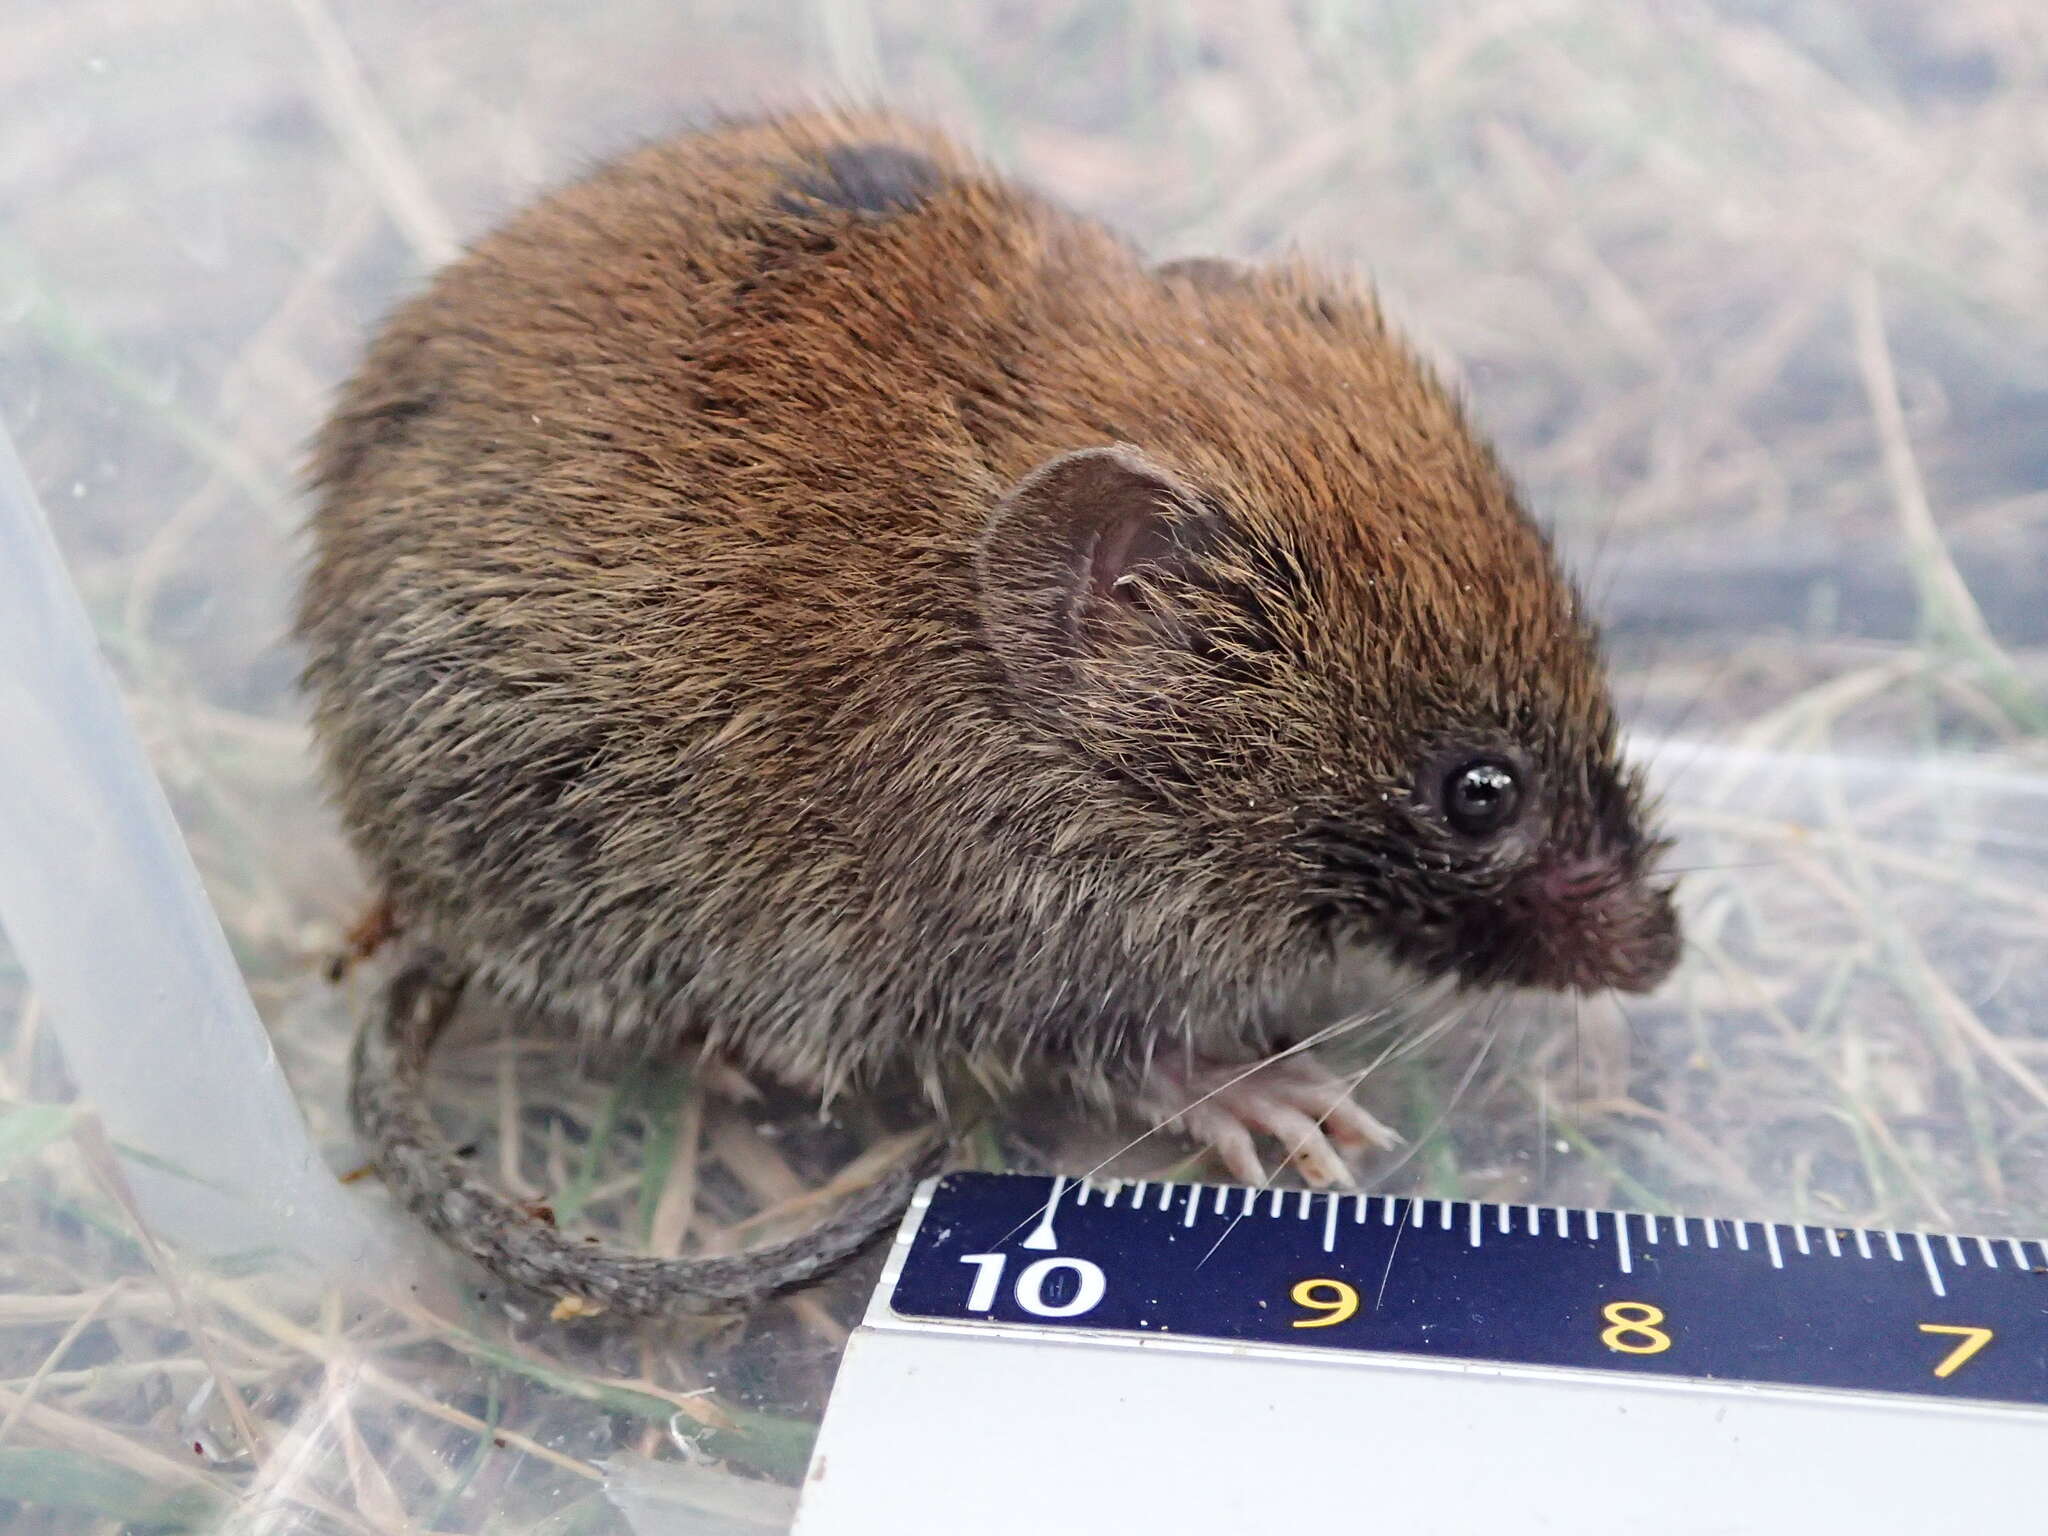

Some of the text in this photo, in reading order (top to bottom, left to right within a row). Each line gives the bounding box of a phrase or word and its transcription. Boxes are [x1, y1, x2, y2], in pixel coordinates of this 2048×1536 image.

[959, 1253, 1994, 1378] 10 9 8 7
